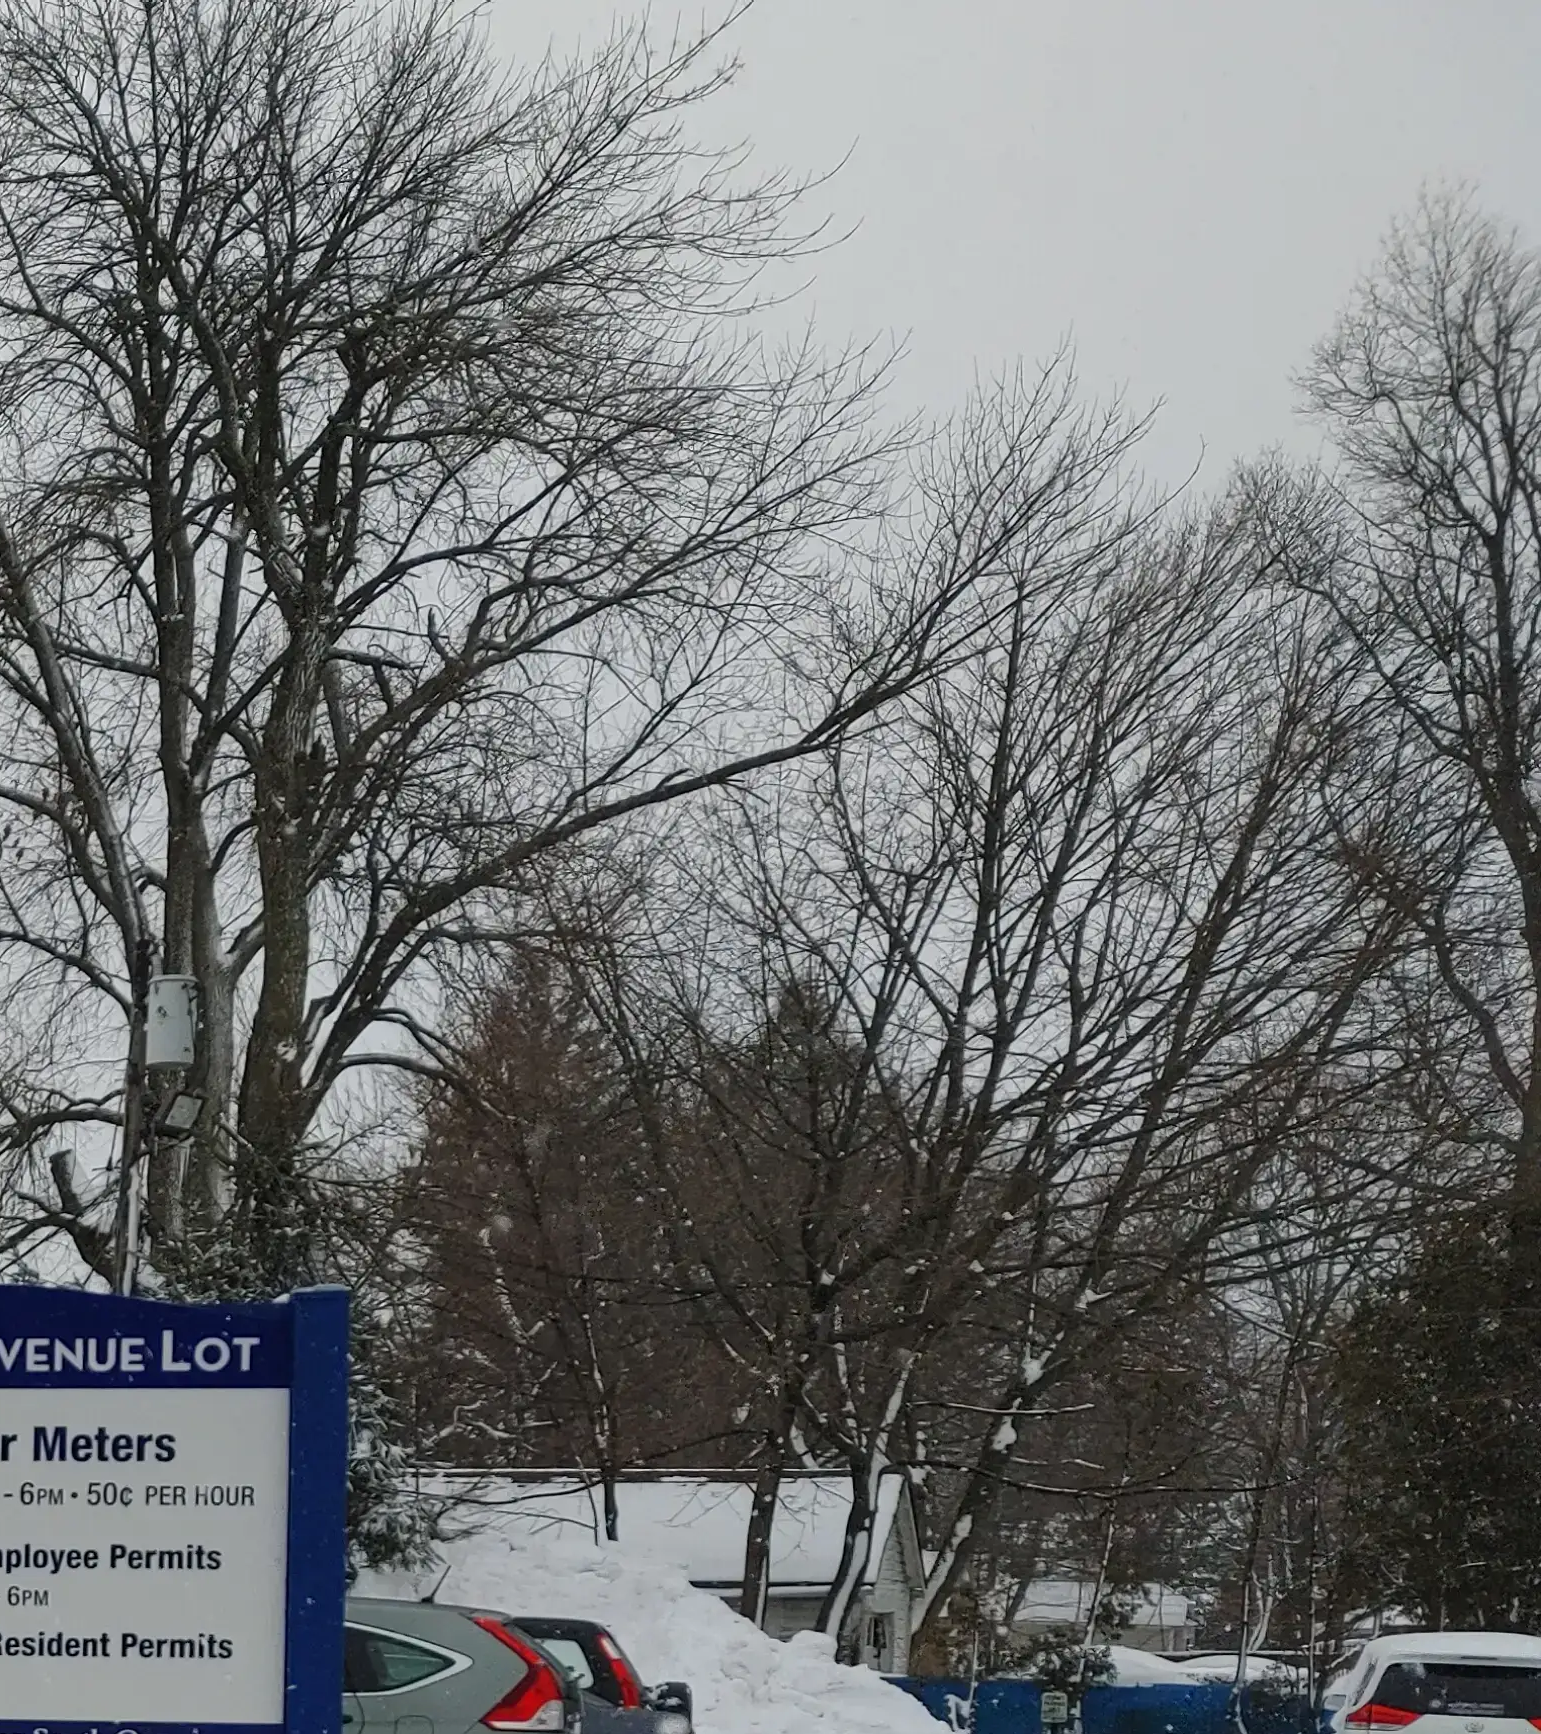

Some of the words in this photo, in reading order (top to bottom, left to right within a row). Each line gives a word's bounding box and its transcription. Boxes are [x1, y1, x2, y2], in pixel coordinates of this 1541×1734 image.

[161, 1329, 261, 1372] LOT
[33, 1425, 176, 1463] Meters
[20, 1481, 64, 1506] 6PM
[87, 1482, 133, 1507] 50¢
[145, 1485, 186, 1506] PER
[195, 1485, 255, 1507] HOUR
[110, 1544, 222, 1570] Permits
[7, 1585, 49, 1606] 6PM
[121, 1632, 233, 1659] Permits
